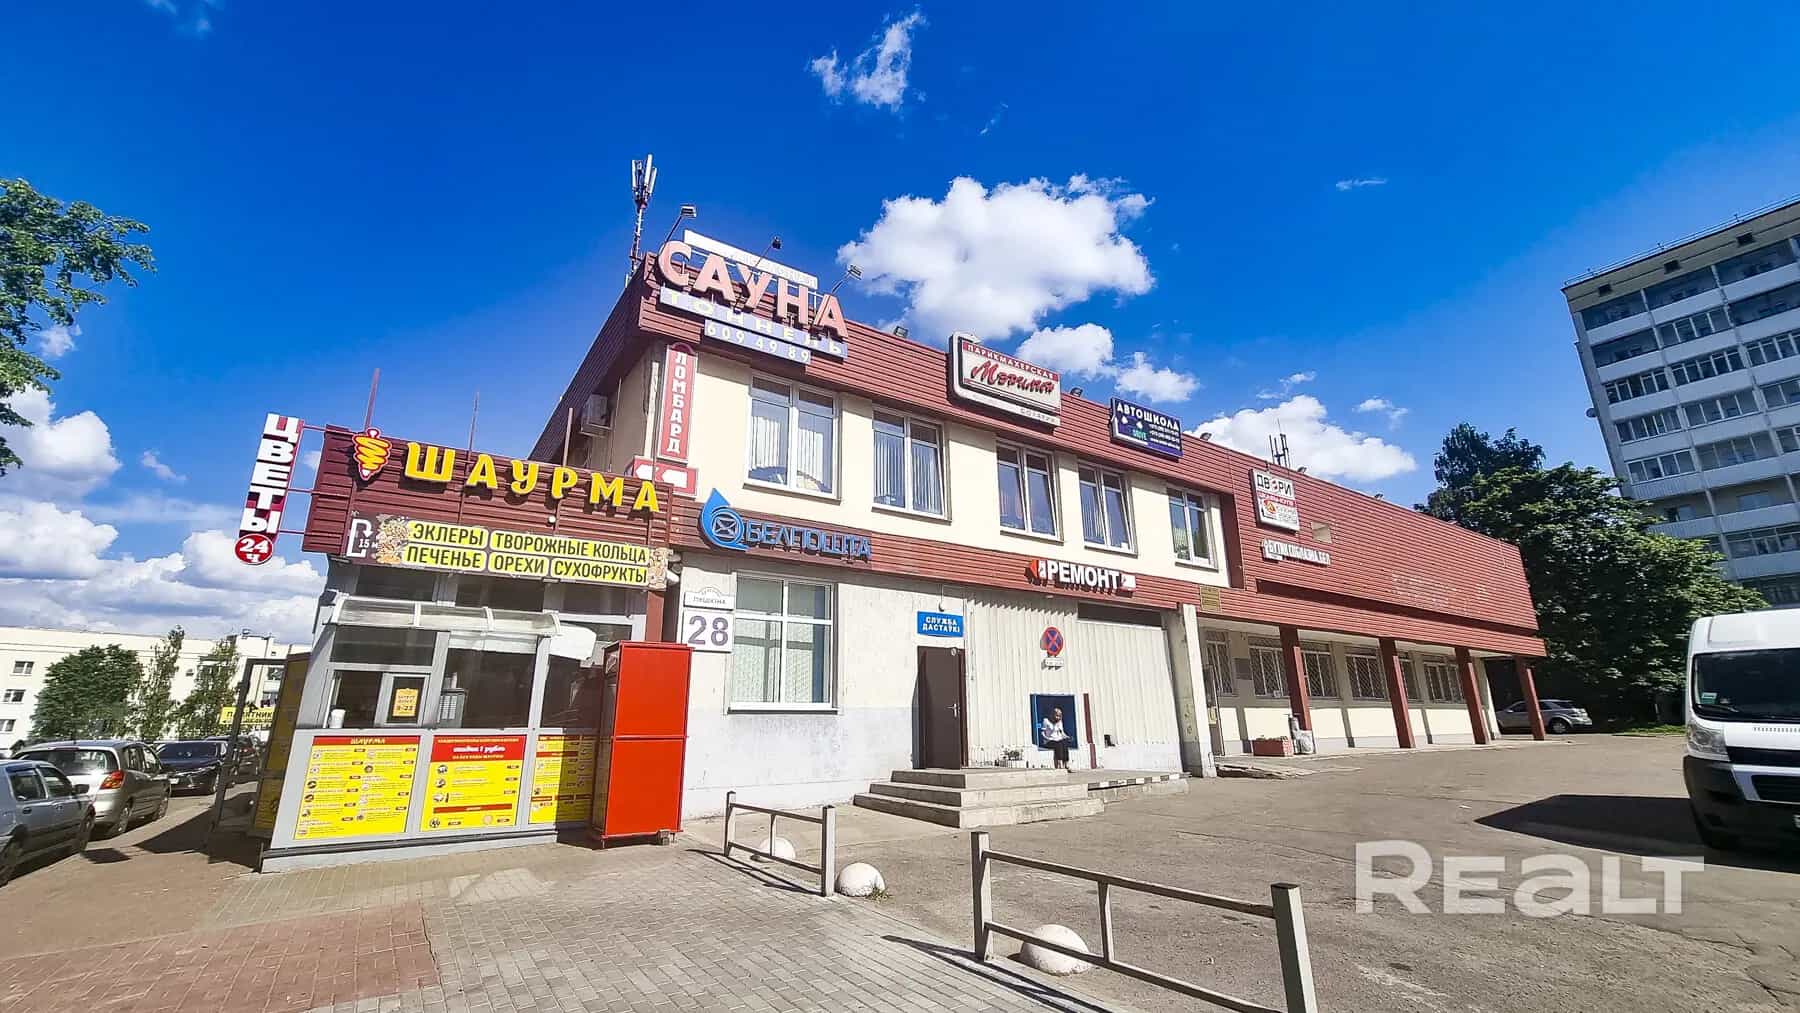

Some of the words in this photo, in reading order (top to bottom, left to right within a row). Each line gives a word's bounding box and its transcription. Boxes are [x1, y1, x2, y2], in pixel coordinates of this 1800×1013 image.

[658, 240, 848, 337] САУНА
[706, 323, 746, 344] 609
[756, 335, 778, 352] 49
[788, 347, 809, 362] 89
[968, 344, 1054, 379] ПАРИКМАХЕРСКАЯ
[667, 352, 687, 453] ЛОМБАРД
[1117, 402, 1179, 431] АВТОШКОЛА
[240, 413, 301, 534] ЦВЕТЫ
[404, 442, 660, 513] ШАУРМА
[240, 538, 268, 554] 24
[358, 538, 370, 549] 15
[413, 523, 484, 547] ЭКЛЕРЫ
[495, 532, 589, 556] ТВОРОЖНЫЕ
[593, 543, 647, 563] КОЛЬЦА
[406, 546, 482, 569] ПЕЧЕНЬЕ
[494, 555, 545, 574] ОРЕХИ
[554, 560, 647, 583] СУХОФРУКТЫ
[1047, 560, 1120, 590] РЕМОНТ
[688, 615, 729, 646] 28
[925, 616, 957, 626] СЛУЖБА
